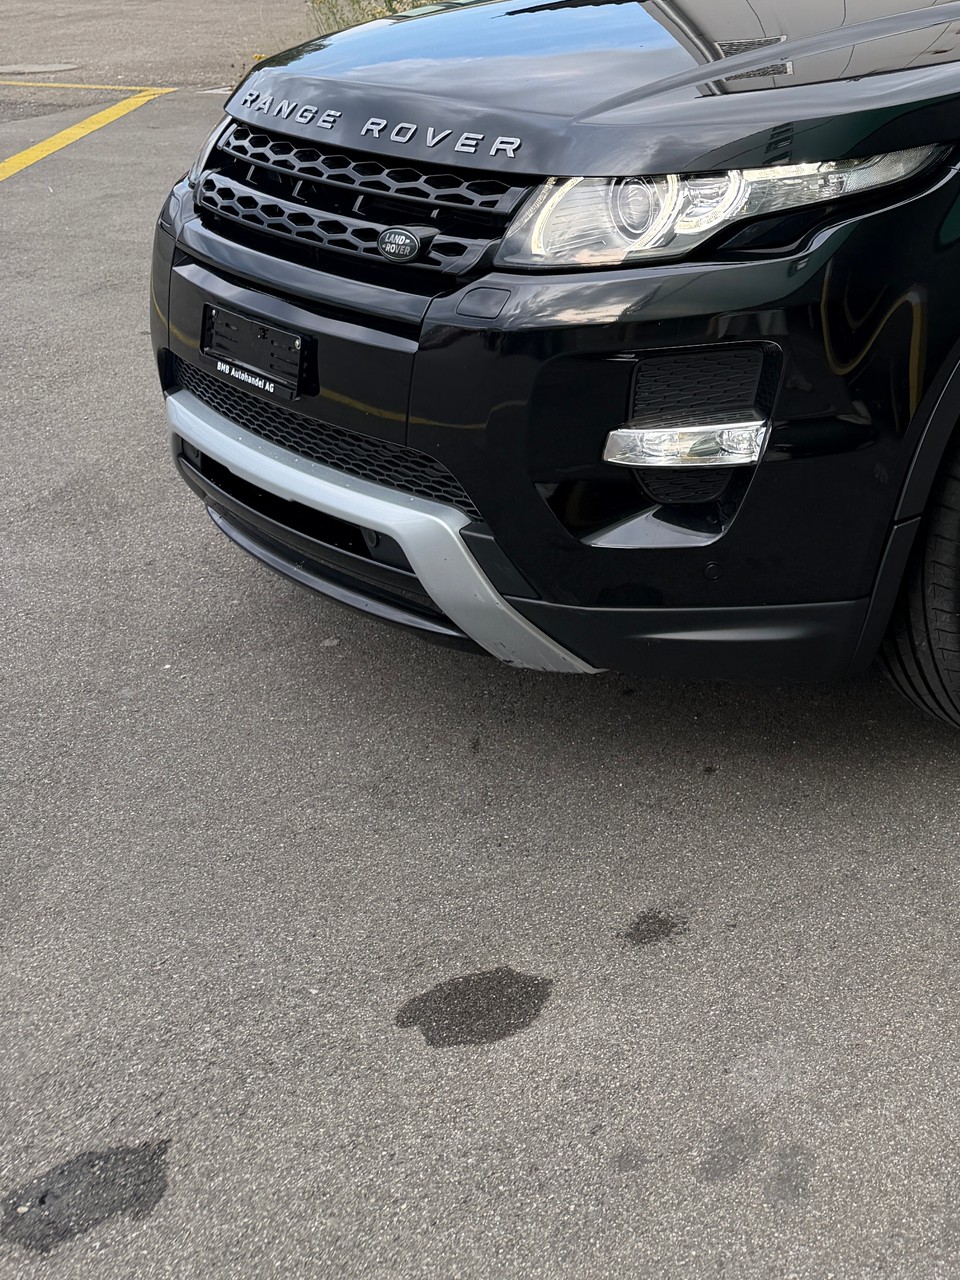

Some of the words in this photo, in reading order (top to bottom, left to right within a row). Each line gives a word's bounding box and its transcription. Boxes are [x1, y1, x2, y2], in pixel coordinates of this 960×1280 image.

[240, 89, 342, 130] RANGE
[360, 117, 522, 158] ROVER
[384, 233, 406, 245] LAND
[385, 243, 411, 255] ROVER
[230, 367, 265, 388] Autohandel
[264, 381, 275, 393] AG
